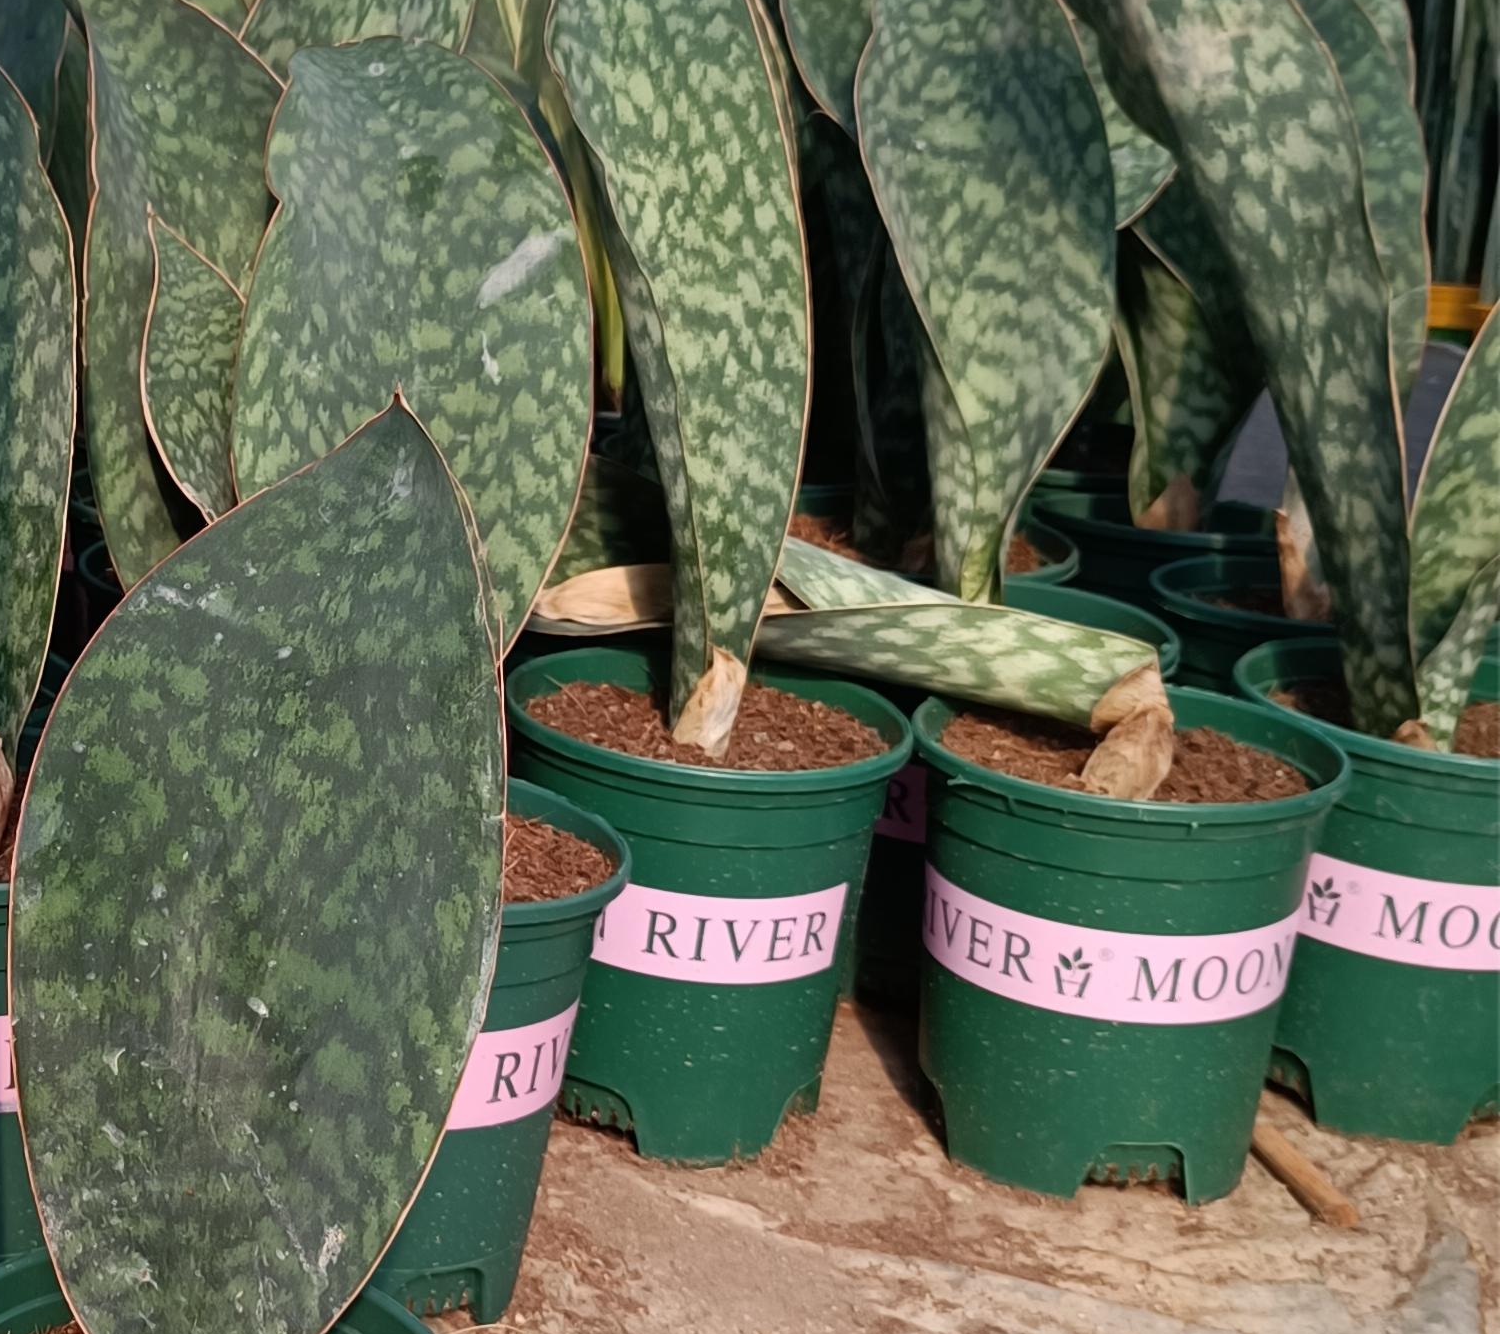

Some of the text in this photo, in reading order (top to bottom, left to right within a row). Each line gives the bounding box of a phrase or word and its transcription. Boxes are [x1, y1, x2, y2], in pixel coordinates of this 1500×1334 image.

[641, 909, 827, 963] RIVER
[1371, 893, 1500, 950] MO
[1127, 933, 1292, 1003] MOON
[486, 1028, 569, 1104] RIV
